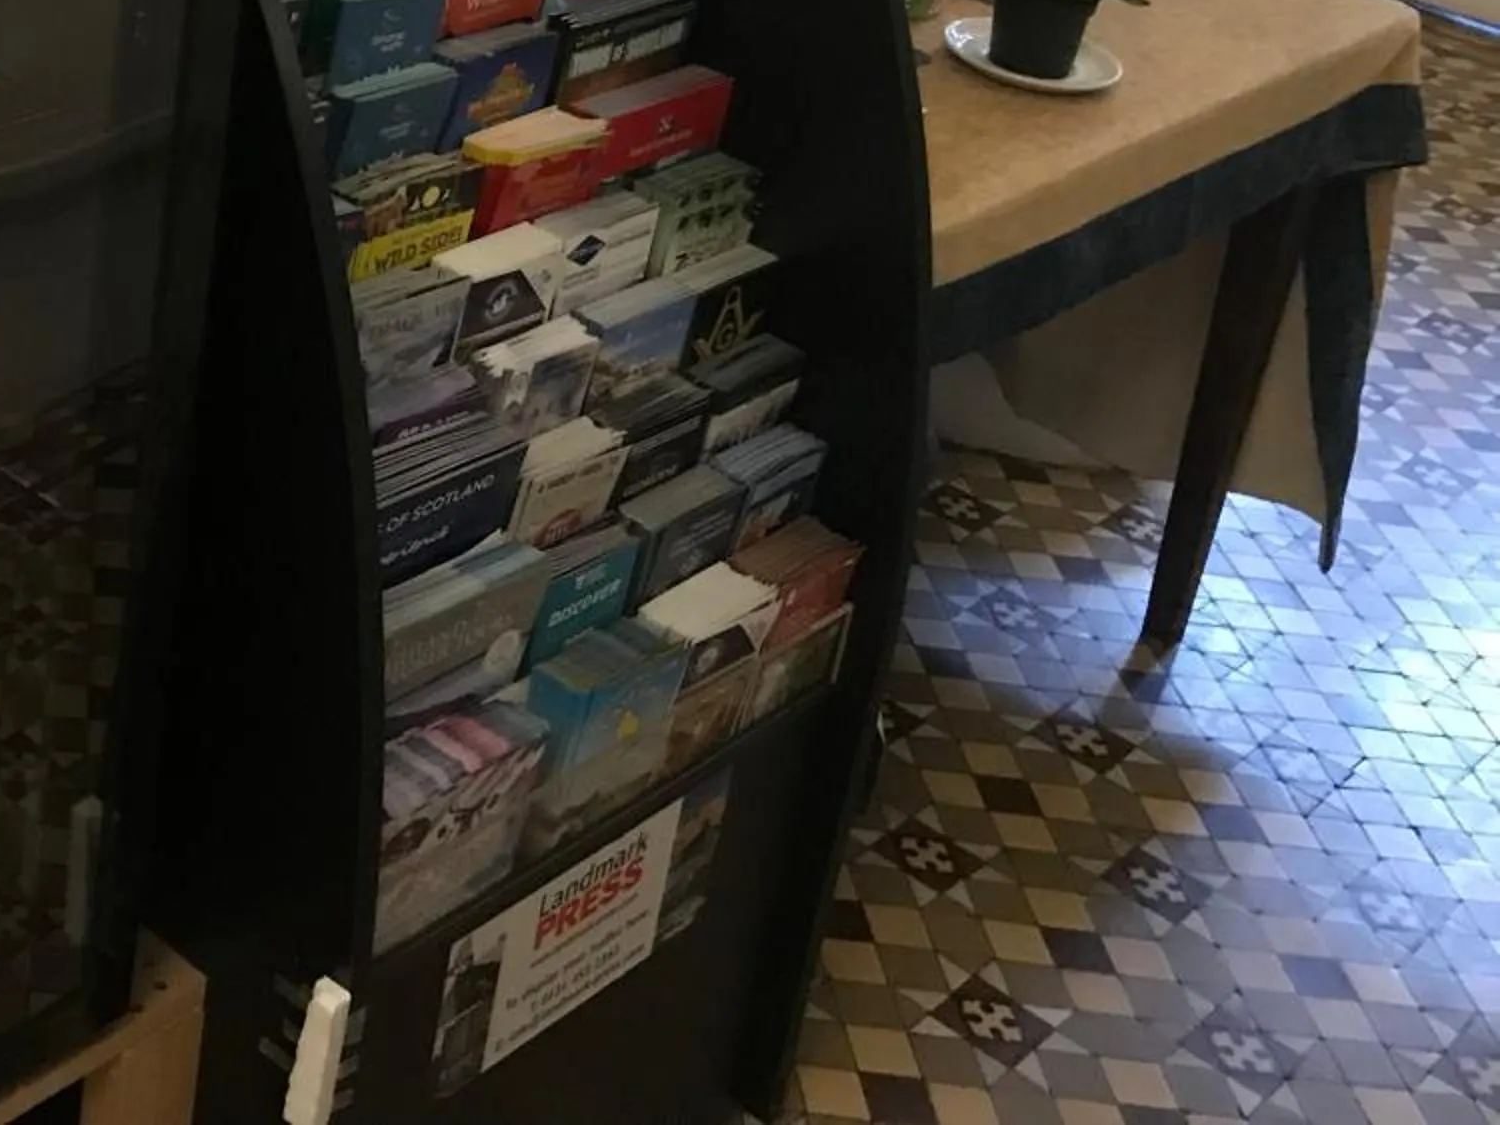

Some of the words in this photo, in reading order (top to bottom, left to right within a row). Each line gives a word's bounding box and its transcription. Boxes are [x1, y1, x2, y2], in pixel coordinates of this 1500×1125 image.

[411, 474, 496, 522] SCOTLAND
[534, 856, 643, 950] PRESS
[539, 830, 647, 917] Landmark
